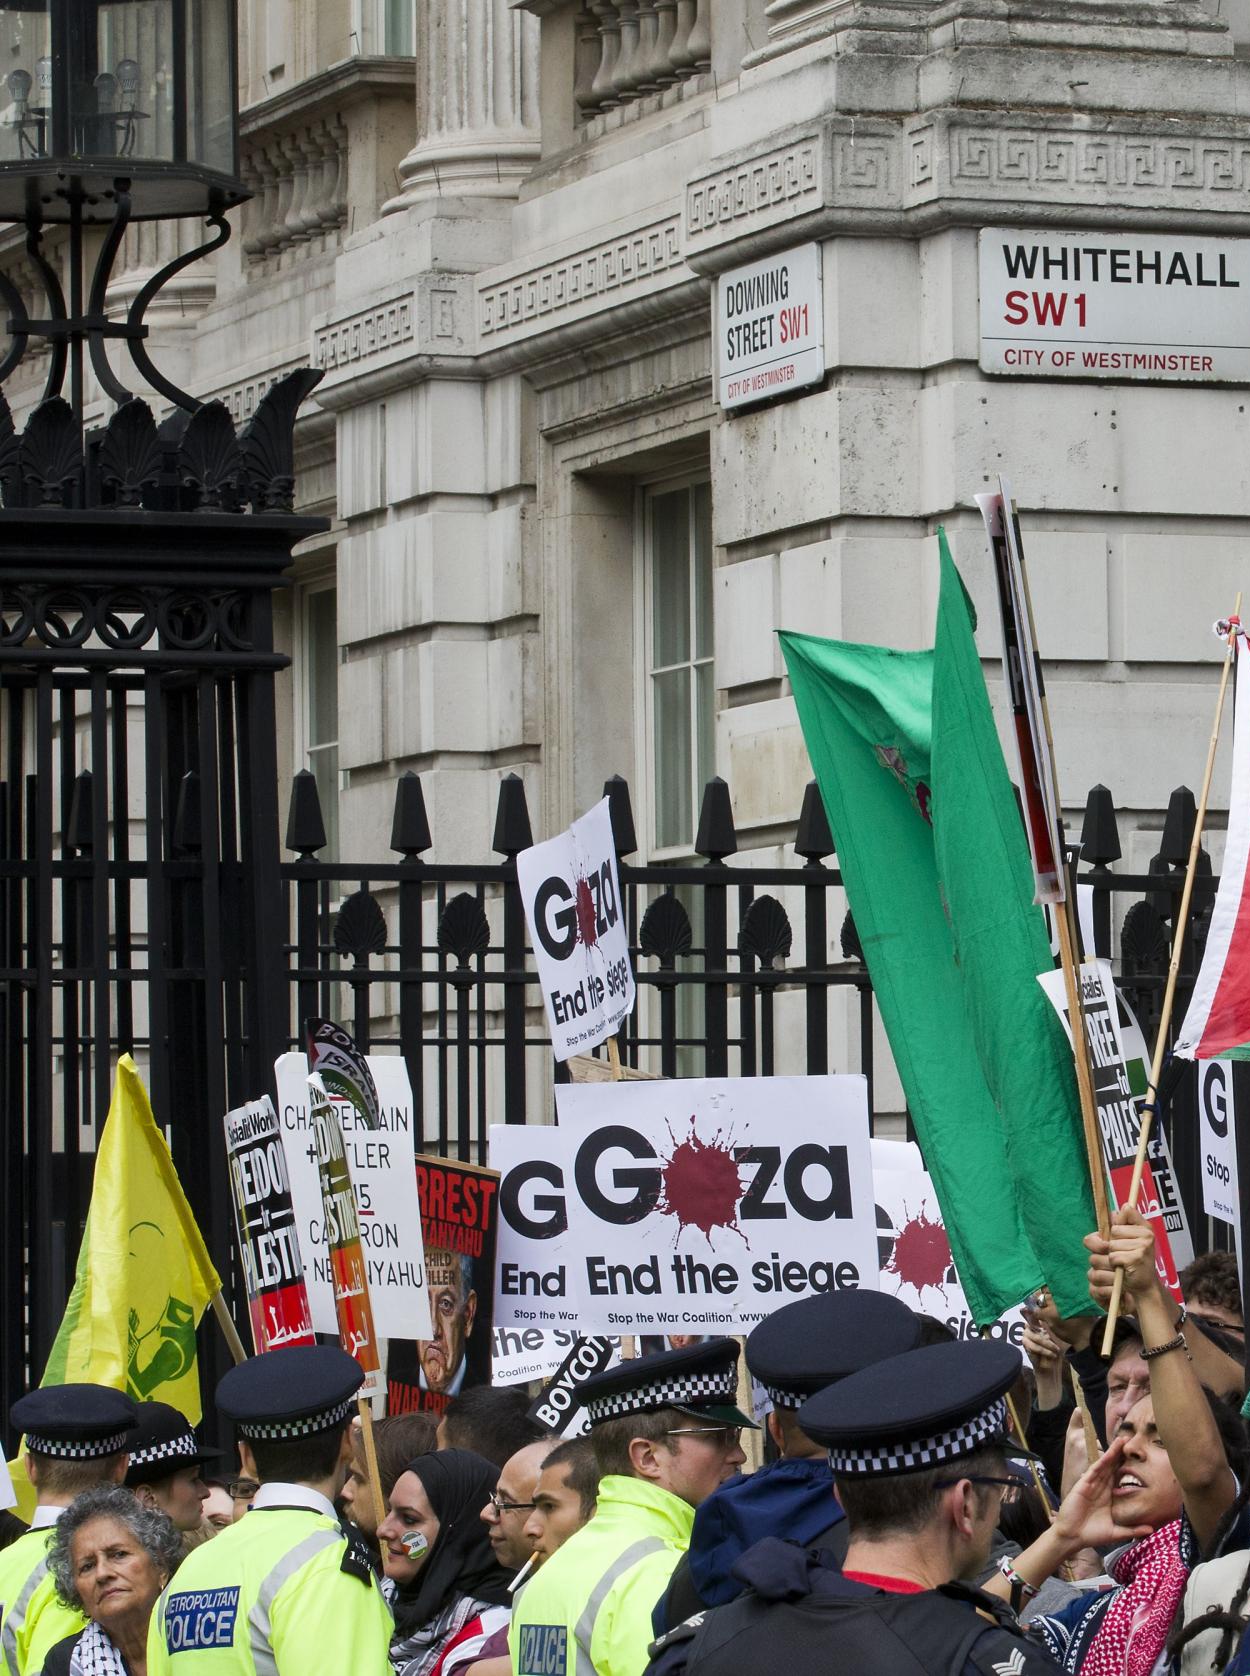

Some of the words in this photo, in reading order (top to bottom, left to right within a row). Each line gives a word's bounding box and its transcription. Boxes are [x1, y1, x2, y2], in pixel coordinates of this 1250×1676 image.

[1003, 245, 1240, 288] WHITEHALL
[727, 266, 788, 318] DOWNING
[1003, 291, 1087, 328] SW1
[727, 314, 774, 361] STREET
[780, 303, 808, 343] SW1
[1004, 348, 1044, 368] CITY
[1051, 350, 1075, 368] OF
[1083, 351, 1213, 372] WESTMINSTER
[728, 381, 740, 399] CITY
[743, 378, 750, 394] OF
[752, 364, 795, 391] WESTMINSTER
[550, 981, 587, 1026] End
[588, 974, 604, 1010] the
[608, 956, 629, 999] siege
[566, 1036, 578, 1047] Stop
[1206, 1154, 1230, 1187] Stop
[424, 1251, 452, 1268] CHILD
[586, 1255, 662, 1296] End
[671, 1254, 739, 1294] the
[502, 1263, 566, 1297] End
[514, 1309, 536, 1321] Stop
[540, 1310, 555, 1320] the
[558, 1311, 578, 1321] War
[608, 1312, 632, 1325] Stop
[636, 1312, 654, 1323] the
[656, 1312, 679, 1323] War
[682, 1311, 732, 1323] Coalition
[498, 1363, 542, 1379] Coalition
[388, 1379, 419, 1417] WAR
[166, 1590, 238, 1616] METROPOLITAN
[166, 1610, 234, 1649] POLICE
[521, 1626, 567, 1675] POLICE
